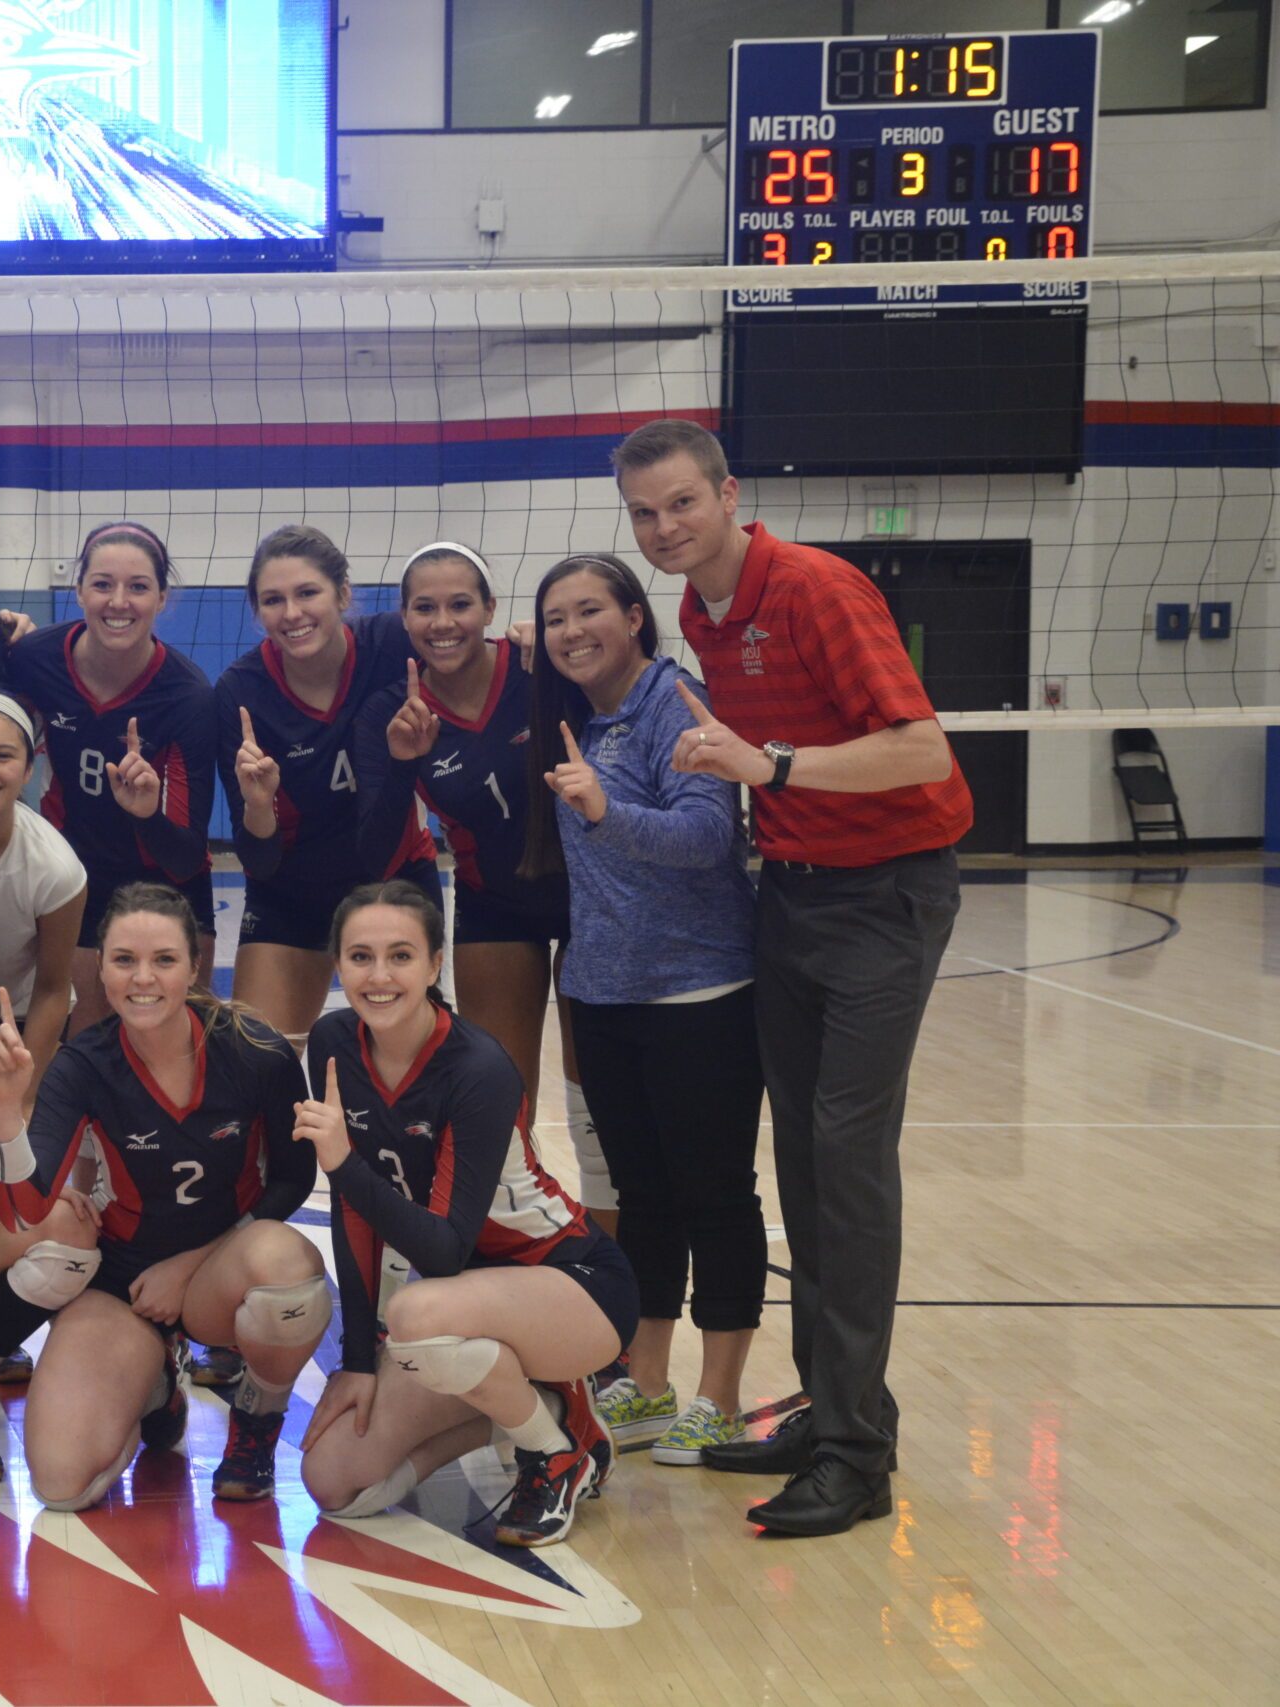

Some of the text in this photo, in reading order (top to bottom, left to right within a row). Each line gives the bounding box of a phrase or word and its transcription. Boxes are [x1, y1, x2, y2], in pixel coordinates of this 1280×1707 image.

[894, 42, 995, 96] 1:15
[749, 114, 836, 141] METRO
[993, 107, 1080, 136] GUEST
[881, 127, 944, 145] PERIOD
[765, 150, 834, 203] 25
[901, 153, 925, 195] 3
[1030, 143, 1078, 194] 17
[739, 212, 794, 230] FOULS
[803, 214, 837, 227] T.O.L.
[850, 208, 970, 228] PLAYER FOUL
[980, 210, 1014, 223] T.O.L.
[1026, 205, 1083, 223] FOULS
[738, 288, 792, 303] SCORE
[877, 285, 938, 301] MATCH
[1023, 281, 1081, 297] SCORE
[741, 646, 760, 660] MSU
[80, 748, 104, 797] 8
[330, 749, 357, 793] 4
[484, 771, 510, 819] 1
[172, 1160, 204, 1205] 2
[378, 1148, 413, 1201] 3
